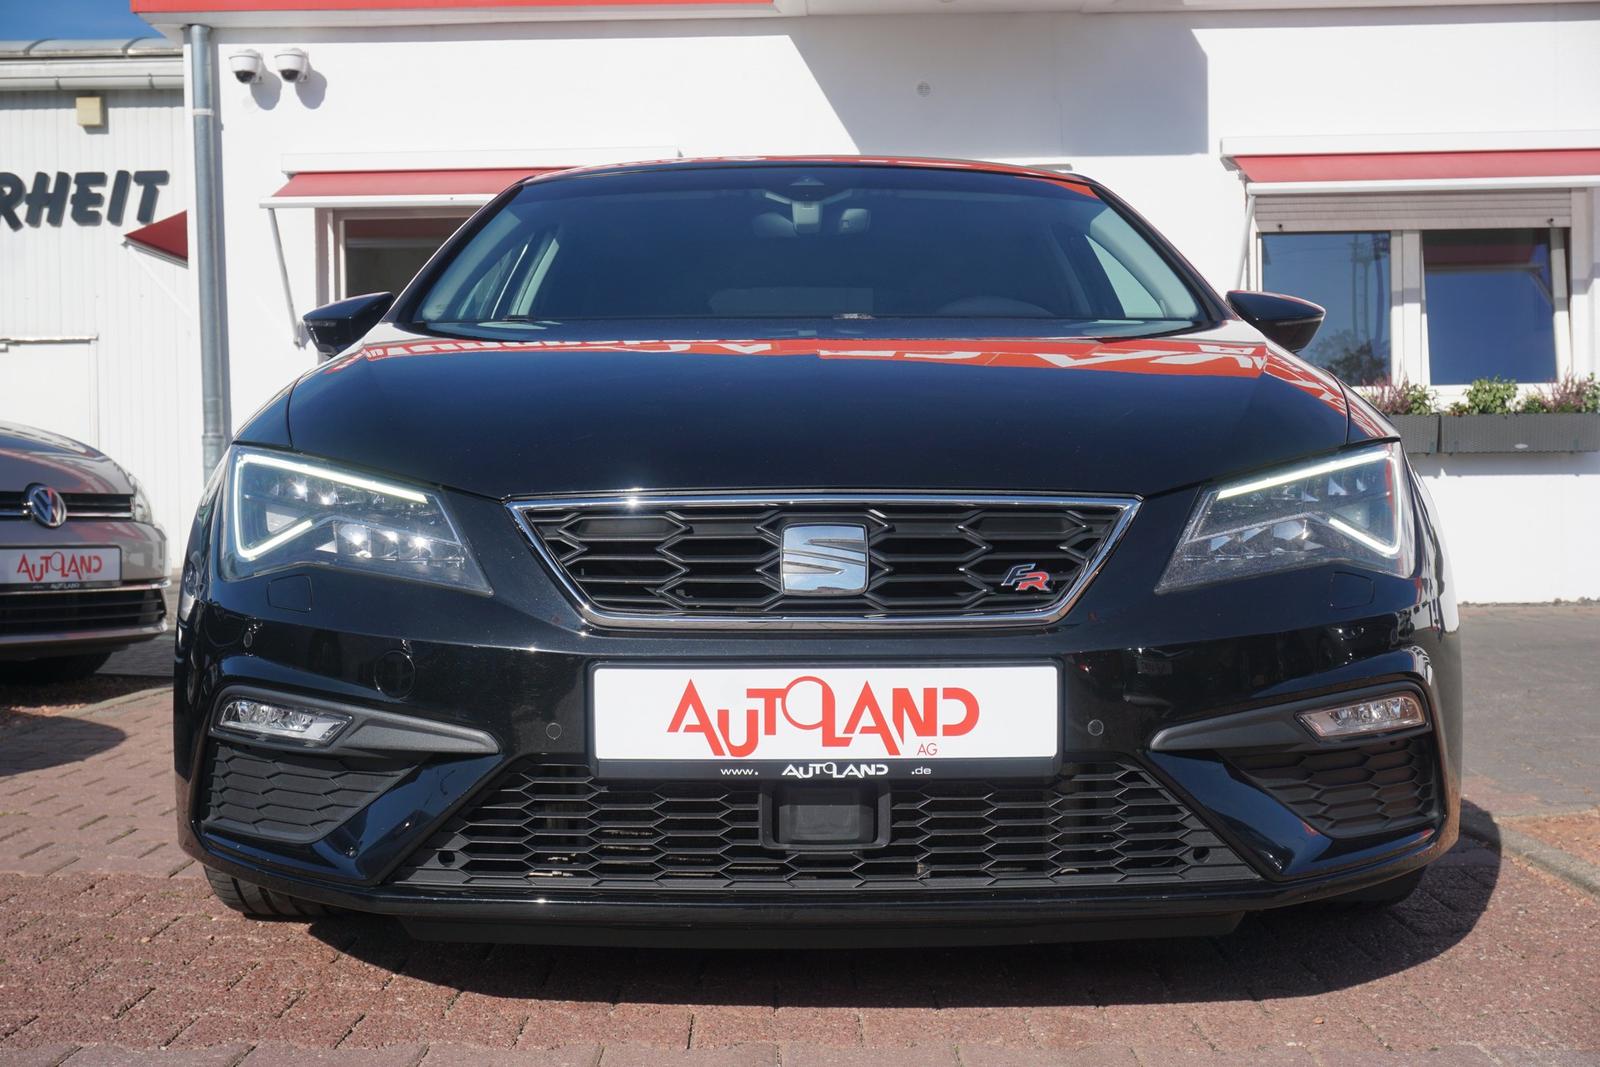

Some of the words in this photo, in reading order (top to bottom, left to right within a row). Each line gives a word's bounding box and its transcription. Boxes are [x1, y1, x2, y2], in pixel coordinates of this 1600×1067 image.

[0, 170, 170, 231] RHEIT
[17, 551, 103, 581] AUTOLAND
[1001, 563, 1050, 591] FR
[667, 676, 980, 757] AUTOLAND
[917, 743, 938, 755] AG
[720, 766, 759, 776] www.
[782, 761, 888, 779] AUTOLAND
[911, 765, 932, 775] .de
